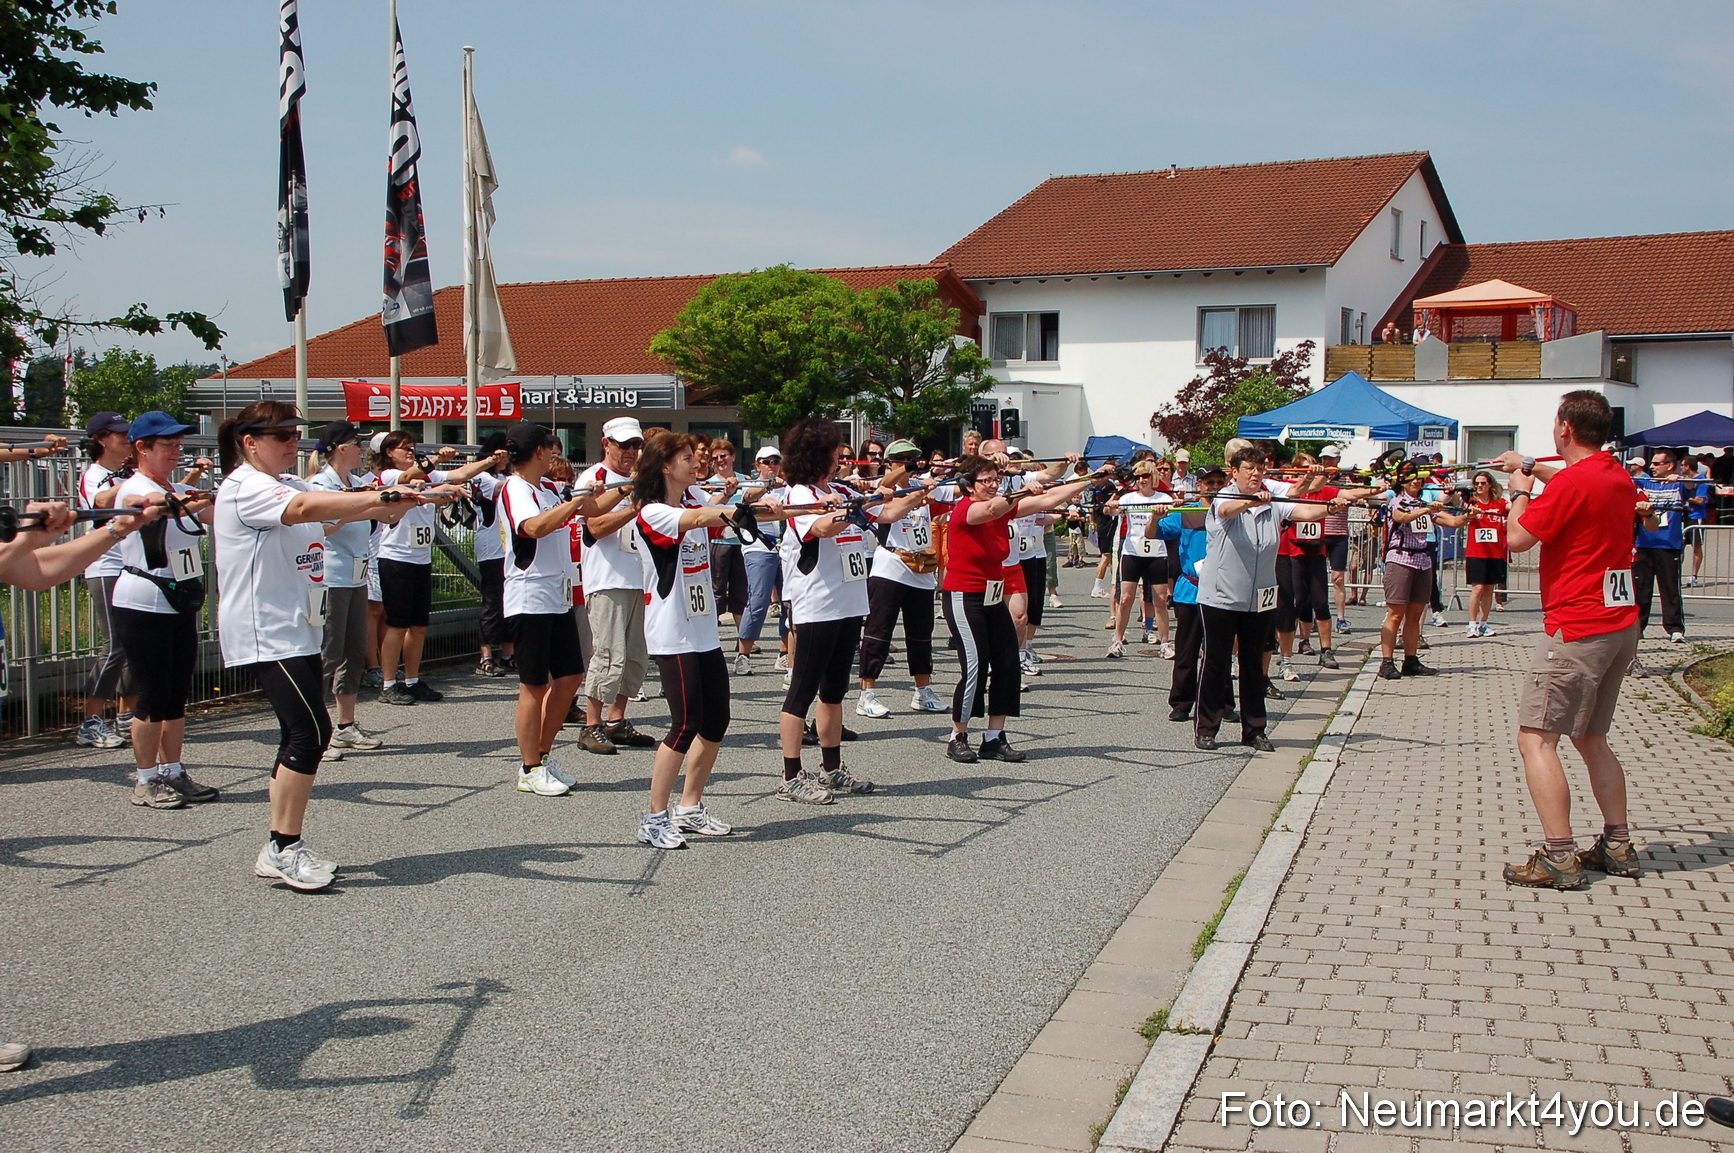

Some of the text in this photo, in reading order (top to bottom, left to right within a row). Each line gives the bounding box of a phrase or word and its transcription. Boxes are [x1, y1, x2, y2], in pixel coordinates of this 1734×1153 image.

[400, 395, 495, 417] START+ZEL
[565, 388, 579, 404] &
[585, 385, 639, 407] Jänig
[1301, 523, 1316, 537] 40
[1415, 515, 1428, 530] 69
[416, 525, 431, 546] 58
[912, 527, 928, 546] 53
[1480, 529, 1493, 541] 25
[1143, 540, 1151, 554] 5
[178, 548, 195, 574] 71
[848, 551, 865, 577] 63
[992, 582, 1004, 602] 14
[1261, 587, 1275, 608] 22
[1609, 572, 1629, 602] 24
[689, 584, 705, 613] 56
